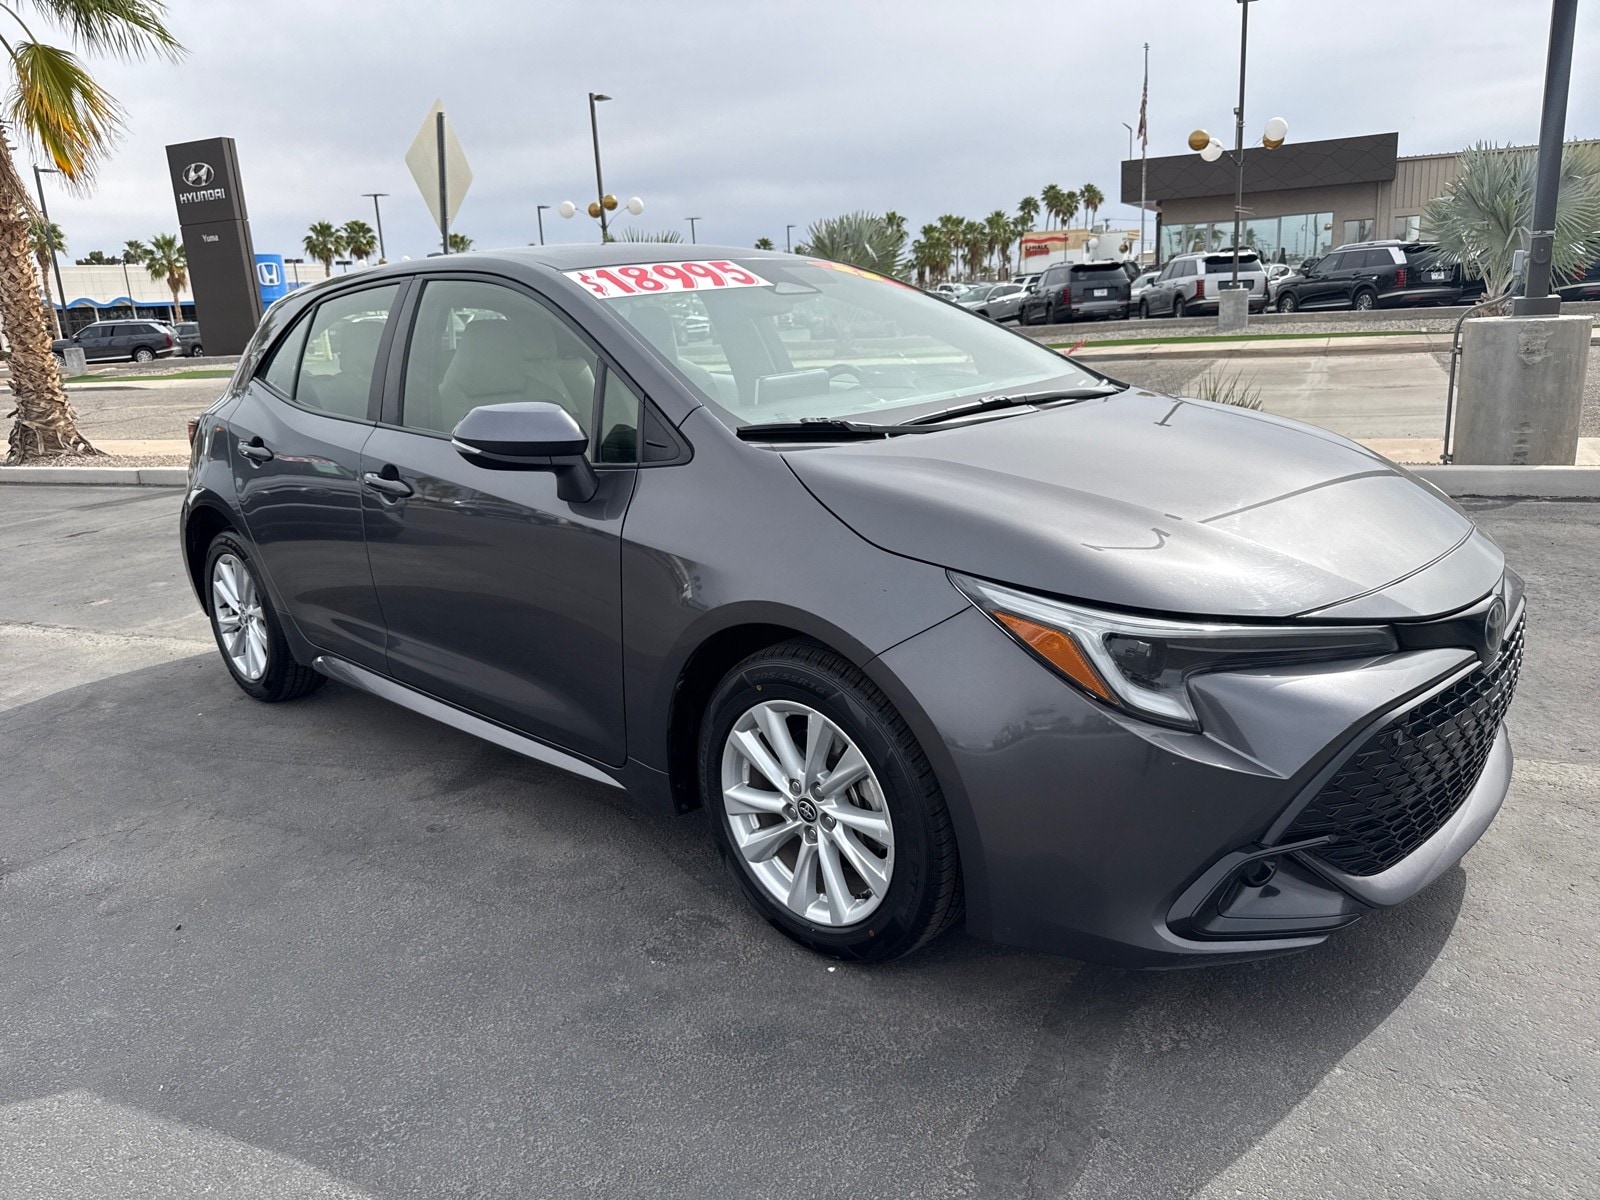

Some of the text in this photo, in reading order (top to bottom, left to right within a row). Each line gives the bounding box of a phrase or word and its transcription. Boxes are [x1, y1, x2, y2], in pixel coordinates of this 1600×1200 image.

[179, 188, 226, 204] HYUNDAI
[202, 234, 219, 242] Yuma
[578, 262, 760, 296] $18995
